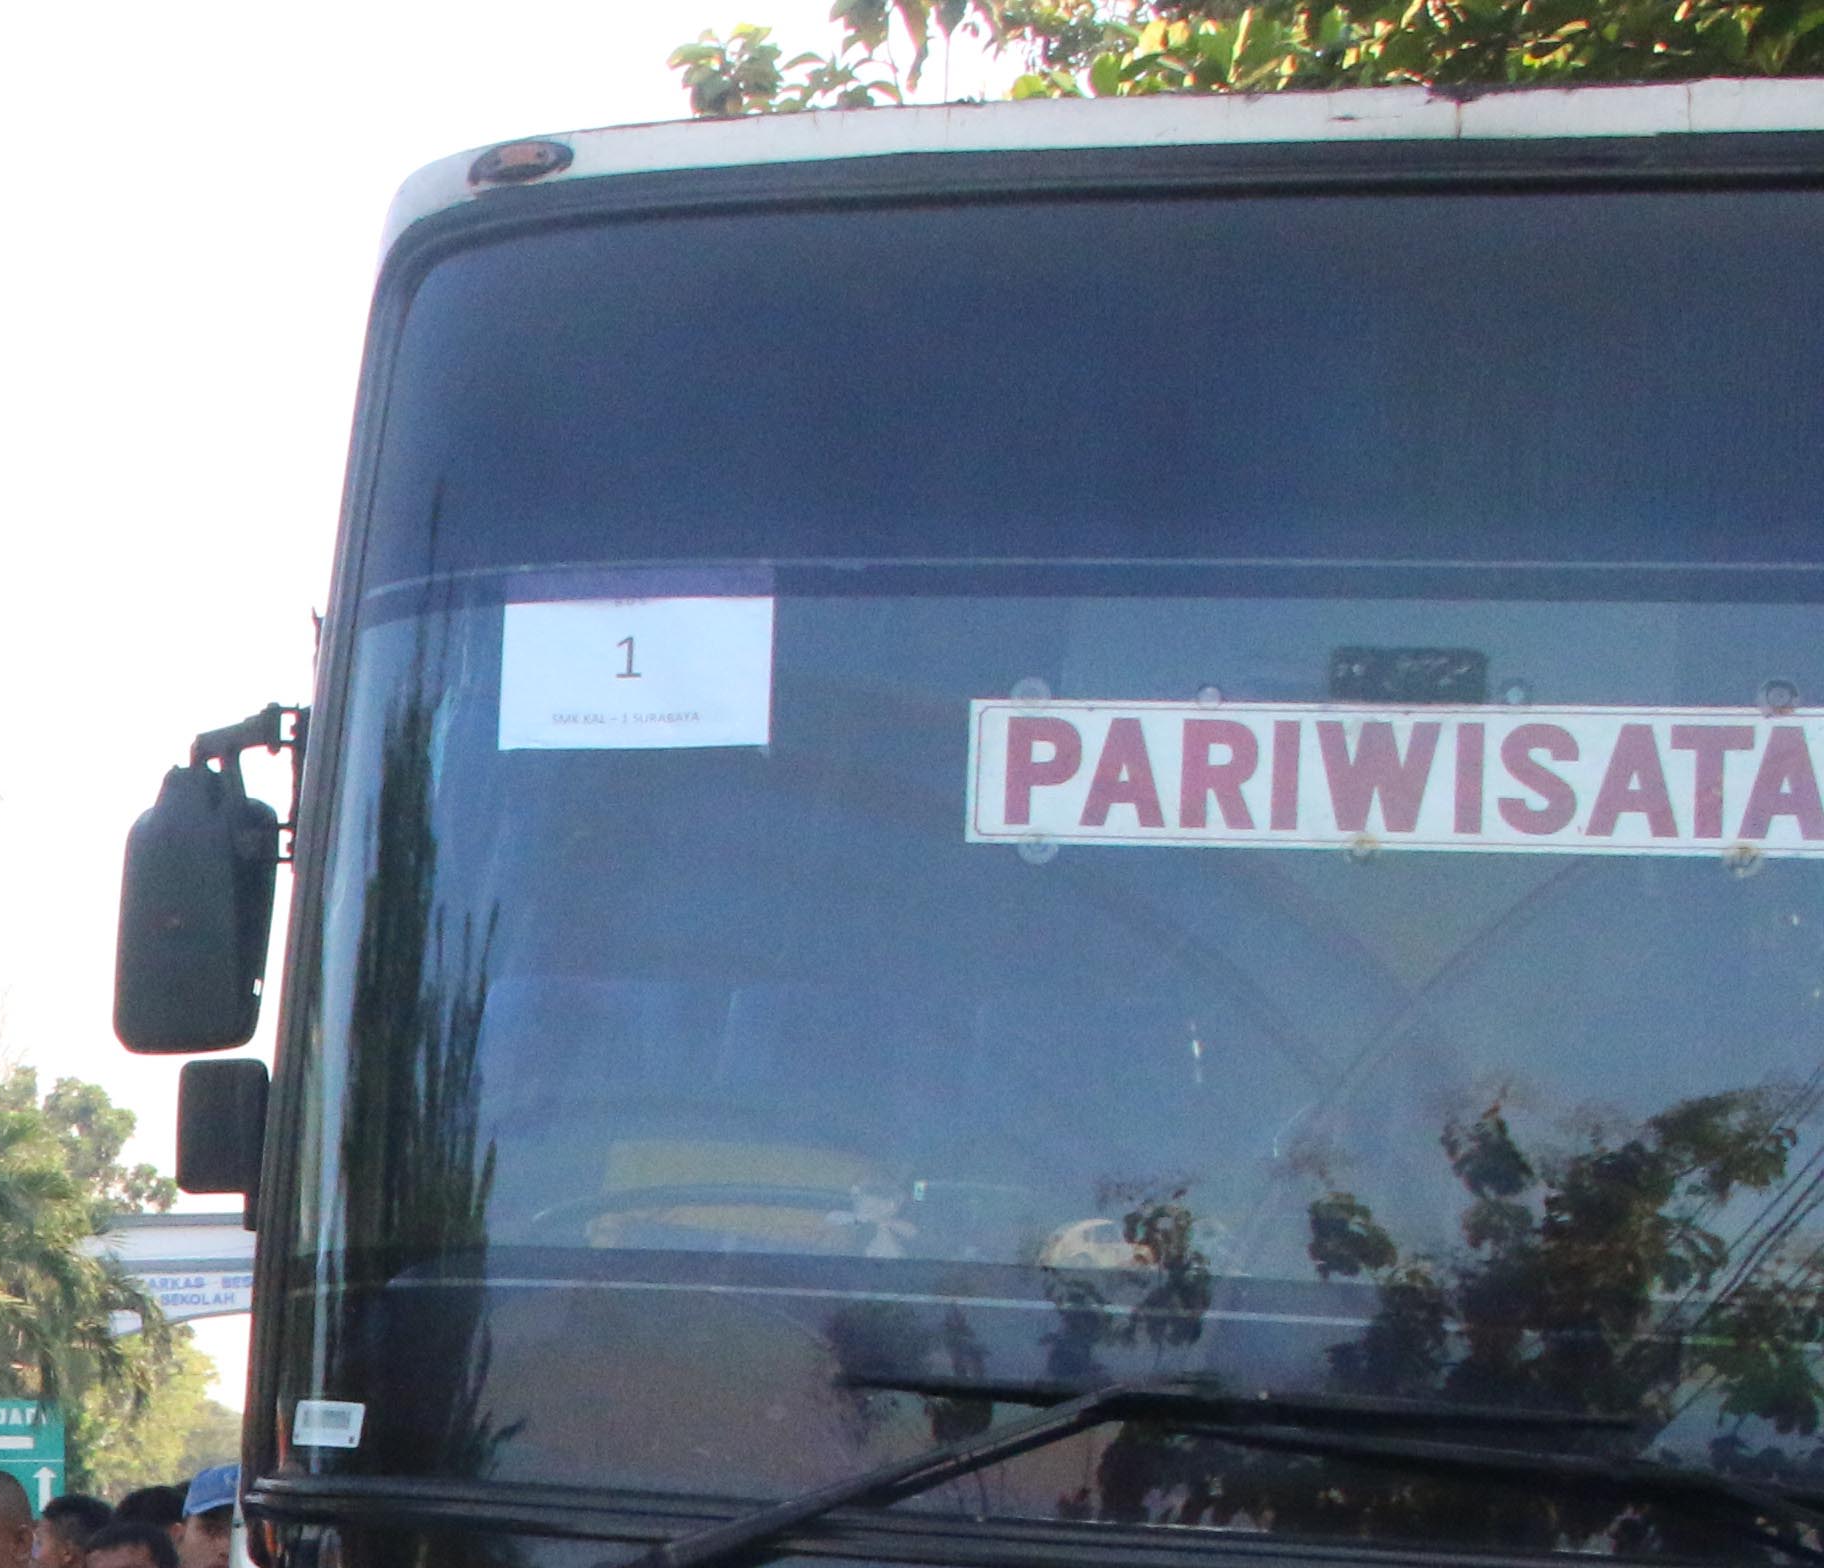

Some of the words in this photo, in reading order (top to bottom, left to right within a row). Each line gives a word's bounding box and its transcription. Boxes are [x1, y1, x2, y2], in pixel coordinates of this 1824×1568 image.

[615, 635, 642, 679] 1
[632, 711, 702, 725] SURABAYA
[1003, 715, 1824, 841] PARIWISATA
[159, 1291, 236, 1306] SEKOLAH
